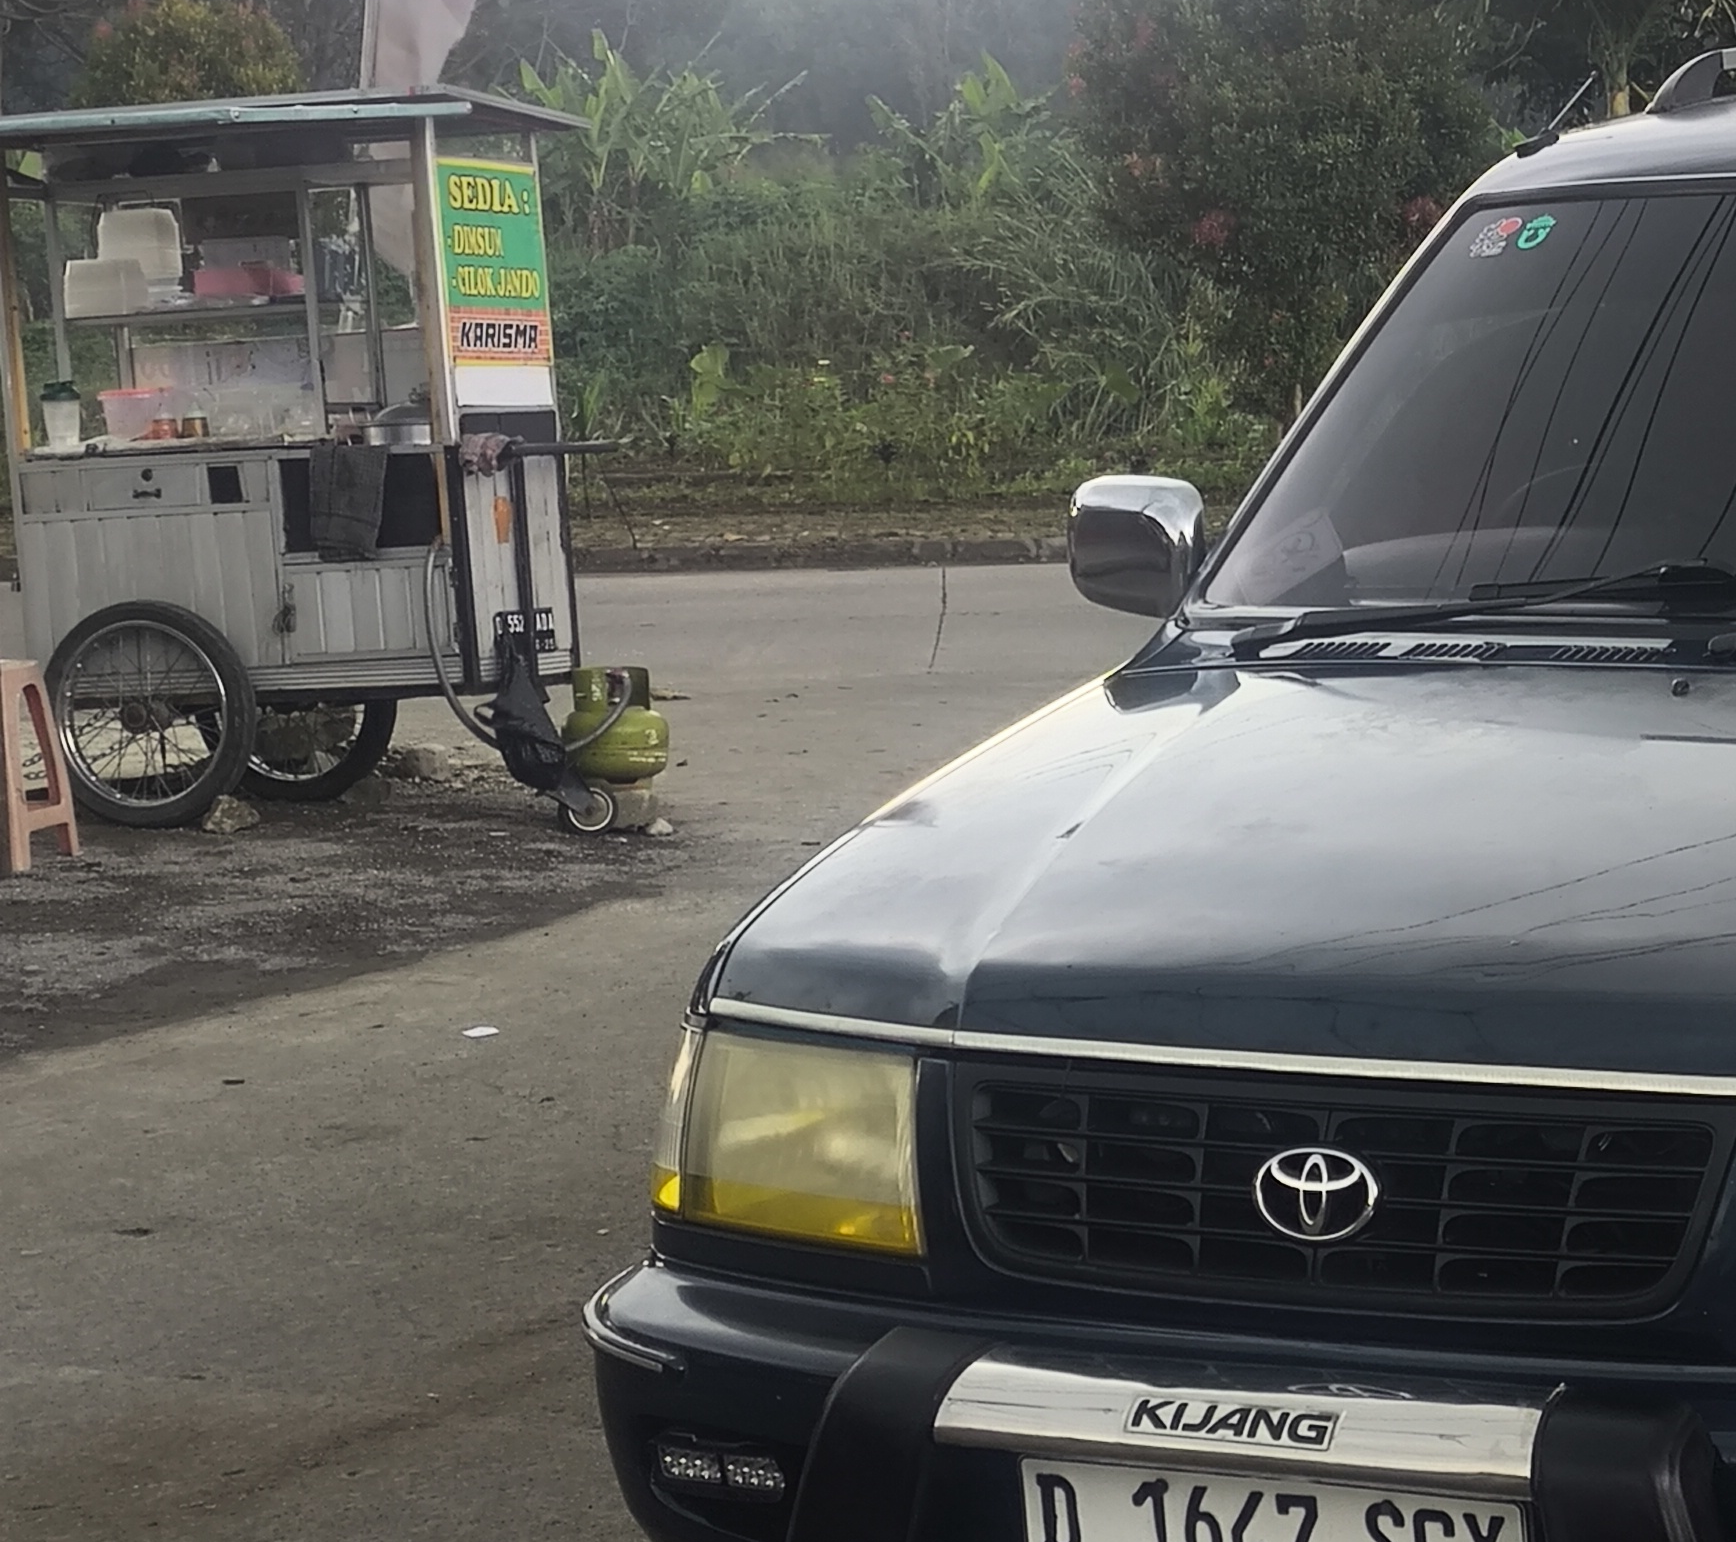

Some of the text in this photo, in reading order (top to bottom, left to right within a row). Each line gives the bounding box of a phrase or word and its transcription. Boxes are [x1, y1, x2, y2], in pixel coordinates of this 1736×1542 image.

[449, 174, 520, 214] SEDIA
[457, 265, 496, 297] CILOK
[497, 267, 541, 300] JANDO
[461, 322, 539, 349] KARISMA
[1131, 1399, 1334, 1446] KIJANG
